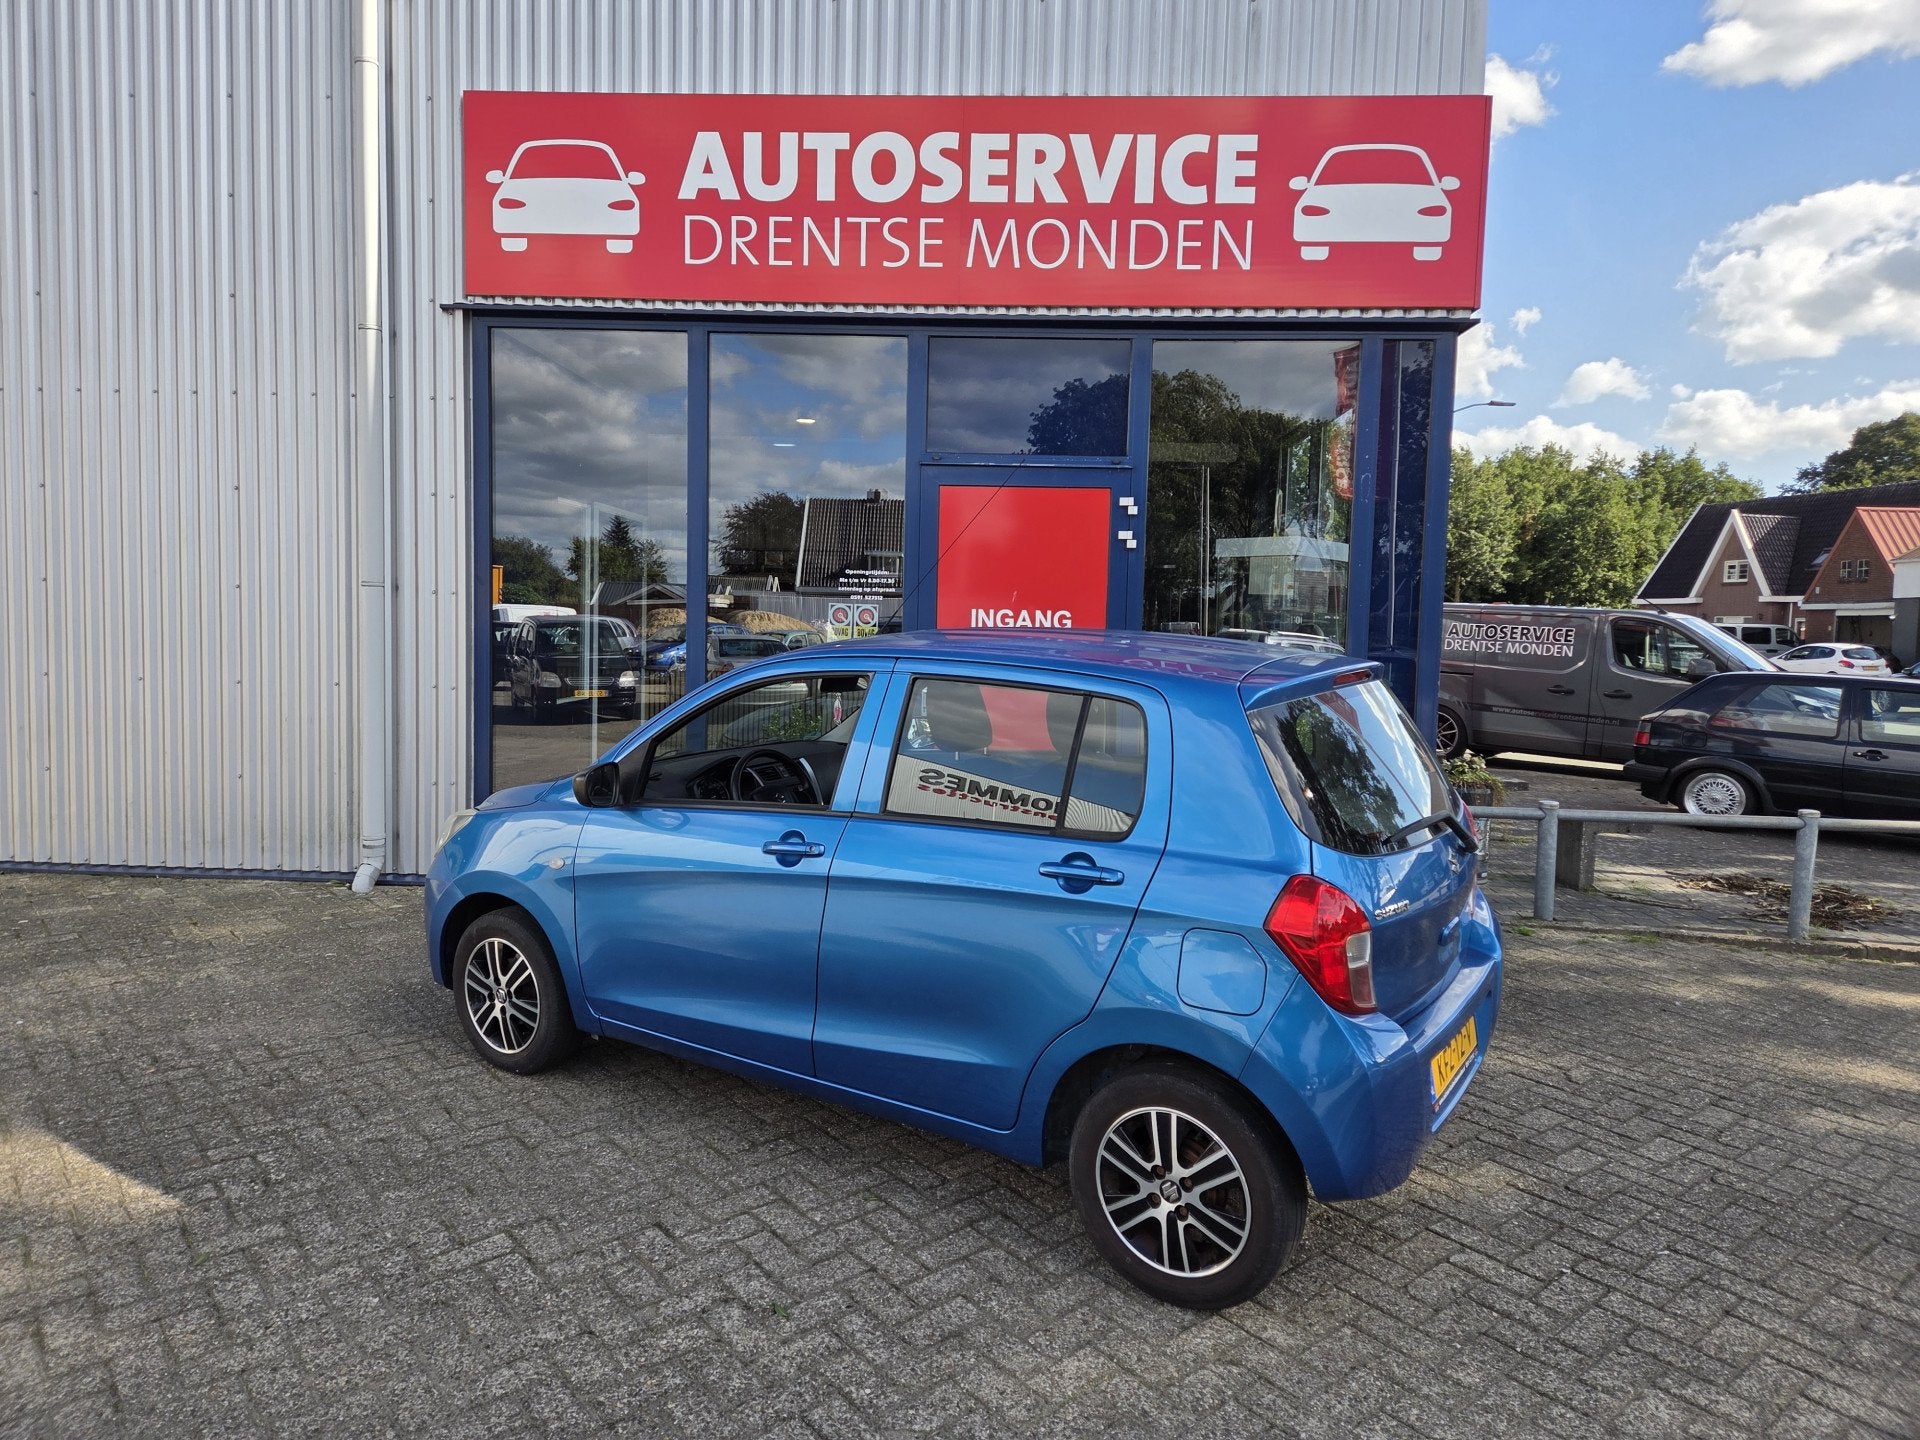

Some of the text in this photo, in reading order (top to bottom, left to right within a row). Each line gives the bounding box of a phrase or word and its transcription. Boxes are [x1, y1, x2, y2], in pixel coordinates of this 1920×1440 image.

[678, 131, 1258, 205] AUTOSERVICE
[683, 214, 1254, 270] DRENTSE MONDEN
[971, 609, 1072, 628] INGANG
[833, 628, 848, 637] OVAG
[1446, 623, 1575, 644] AUTOSERVICE
[1444, 638, 1574, 658] DRENTSE MONDEN
[1492, 706, 1620, 726] www.autoservicedrentsemonden.nl
